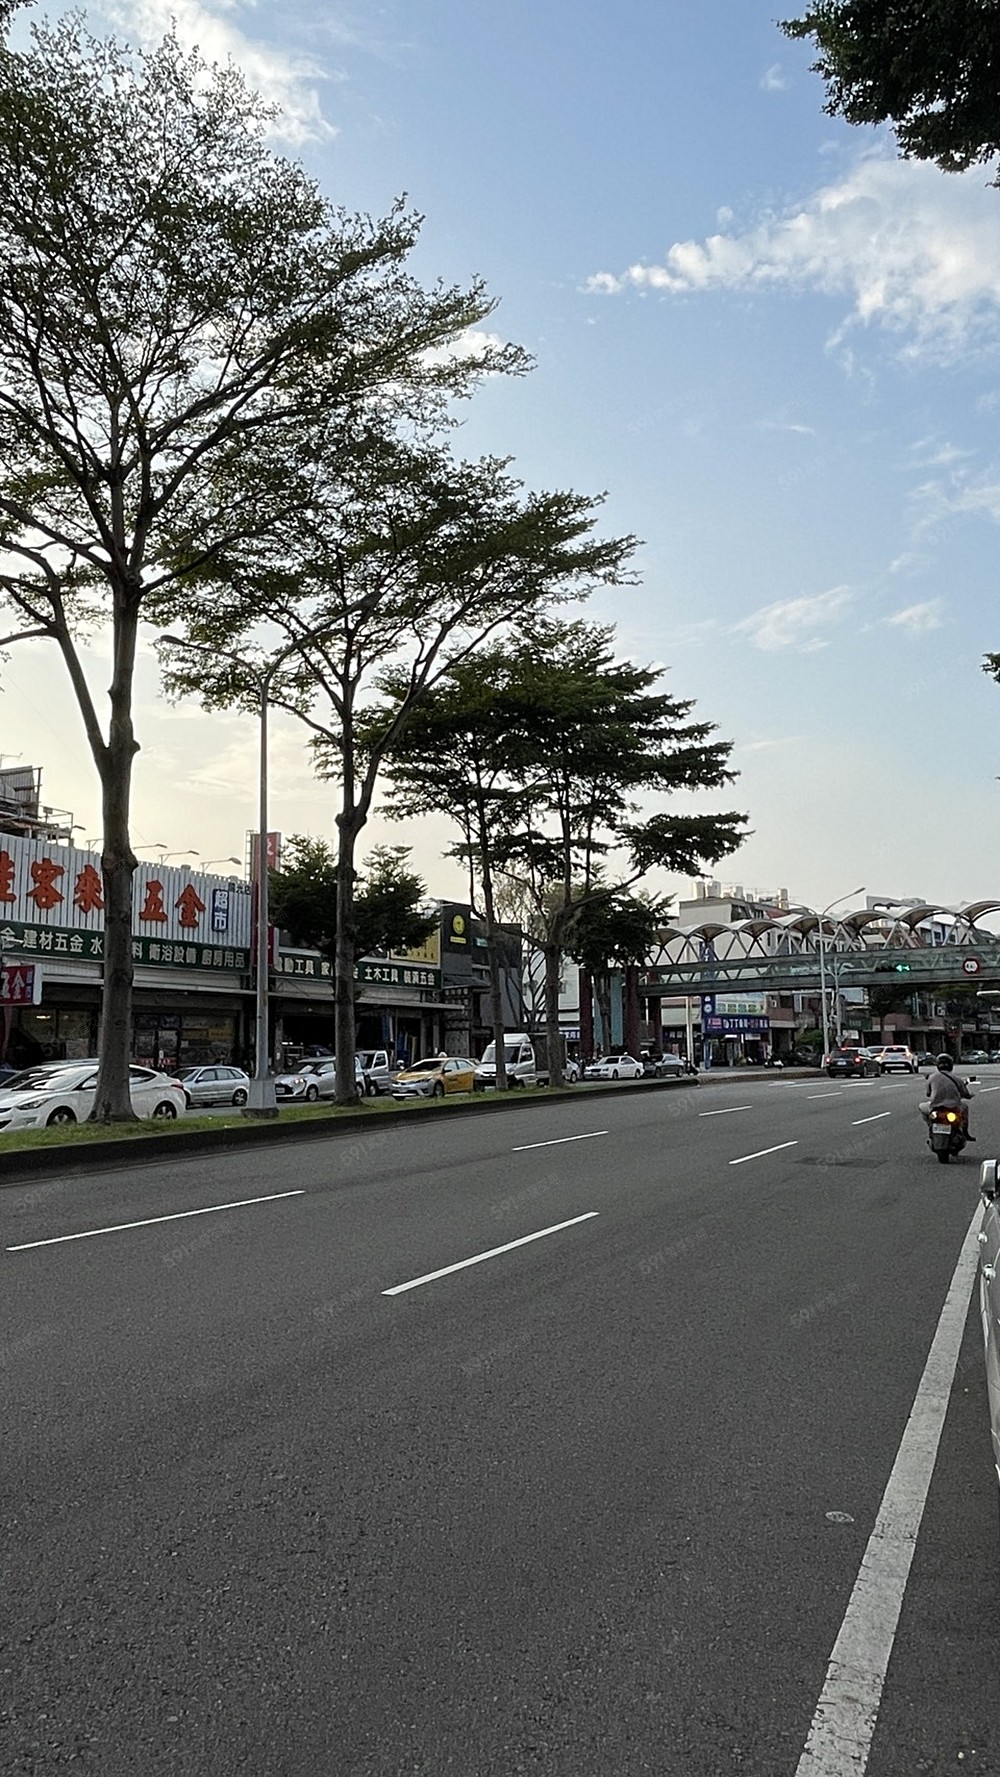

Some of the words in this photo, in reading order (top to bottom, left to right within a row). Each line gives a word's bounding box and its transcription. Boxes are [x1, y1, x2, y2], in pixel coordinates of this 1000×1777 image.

[214, 890, 228, 930] 超市
[23, 928, 85, 953] 建材五金
[365, 966, 398, 983] 土木工具
